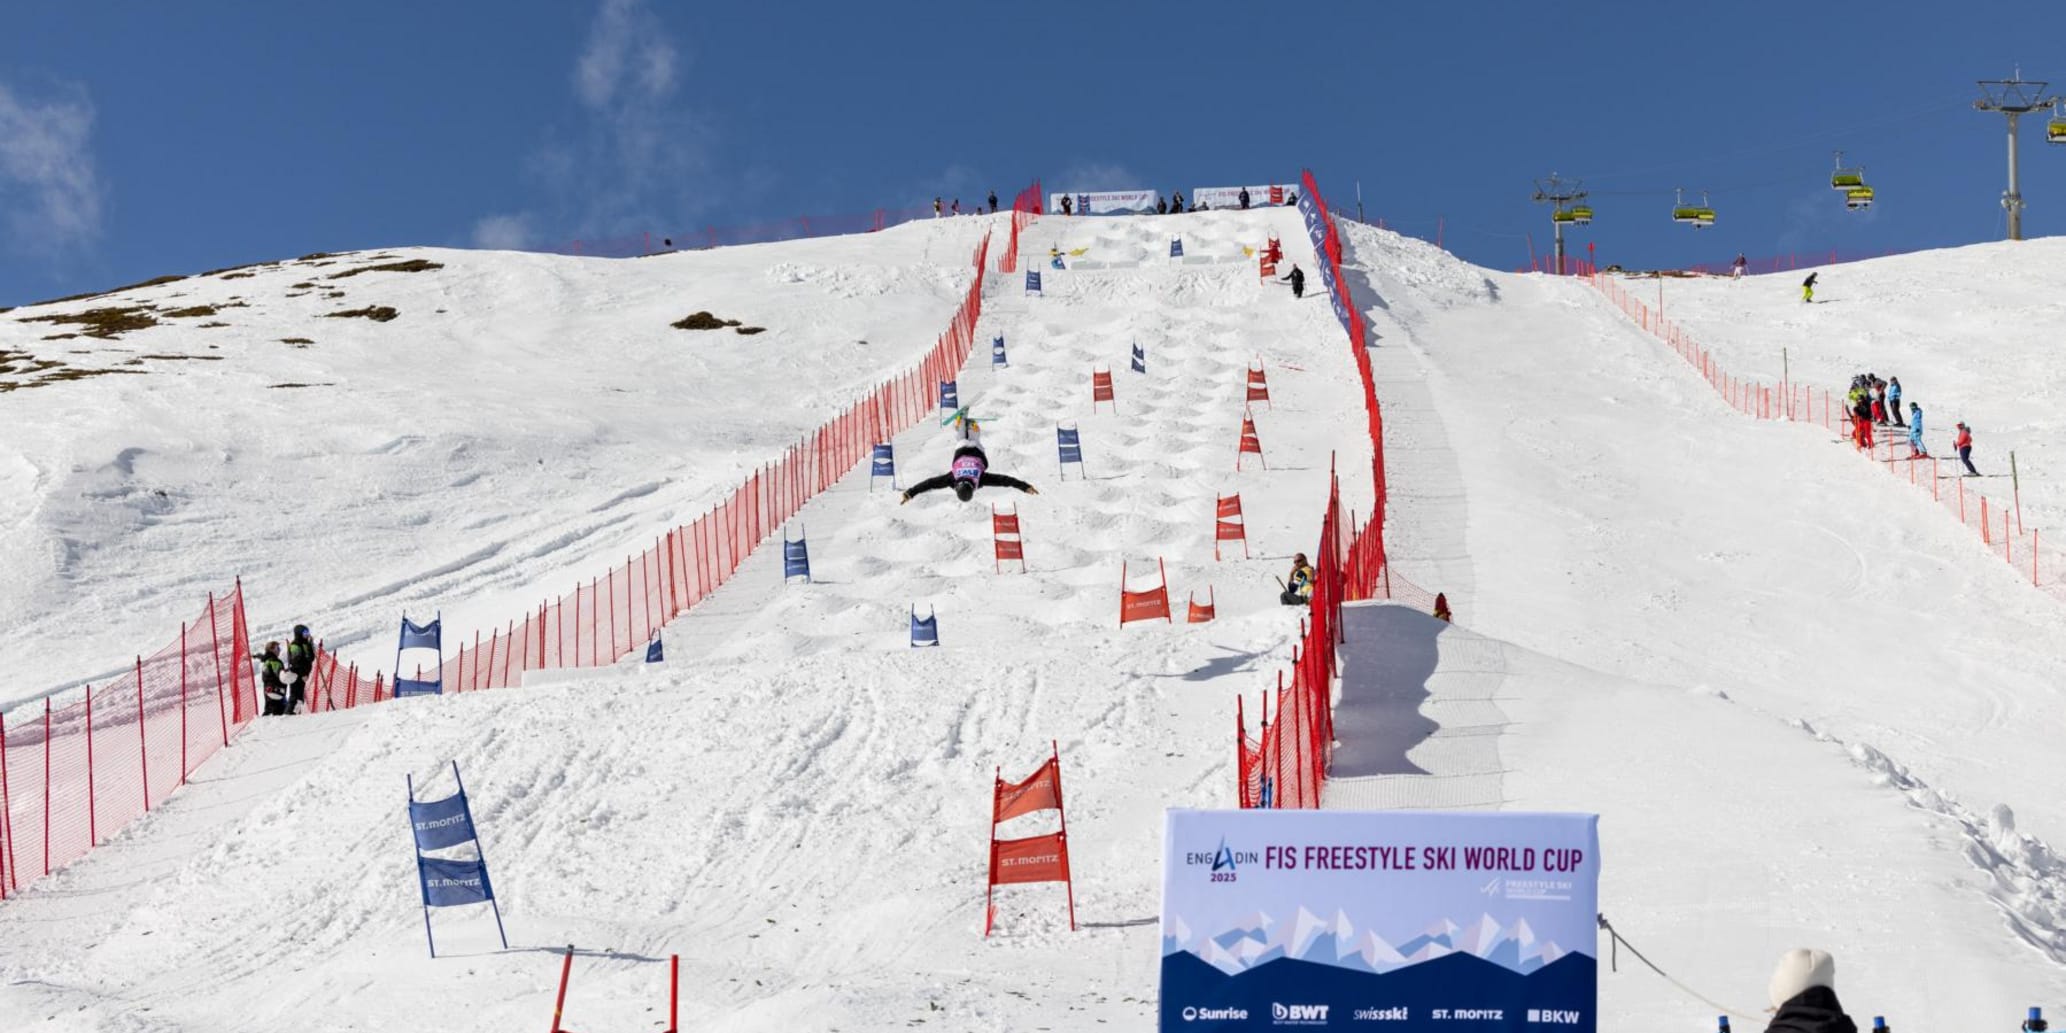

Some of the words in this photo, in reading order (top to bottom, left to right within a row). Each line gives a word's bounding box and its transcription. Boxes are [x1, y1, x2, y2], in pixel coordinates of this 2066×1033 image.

[1265, 846, 1297, 870] FIS
[1304, 846, 1416, 871] FREESTYLE
[1423, 847, 1456, 871] SKI
[1464, 847, 1535, 871] WORLD
[1543, 849, 1583, 873] CUP
[1210, 873, 1237, 883] 2025
[1199, 1006, 1248, 1020] Sunrise
[1289, 1004, 1329, 1020] BWT
[1541, 1010, 1579, 1023] BKW
